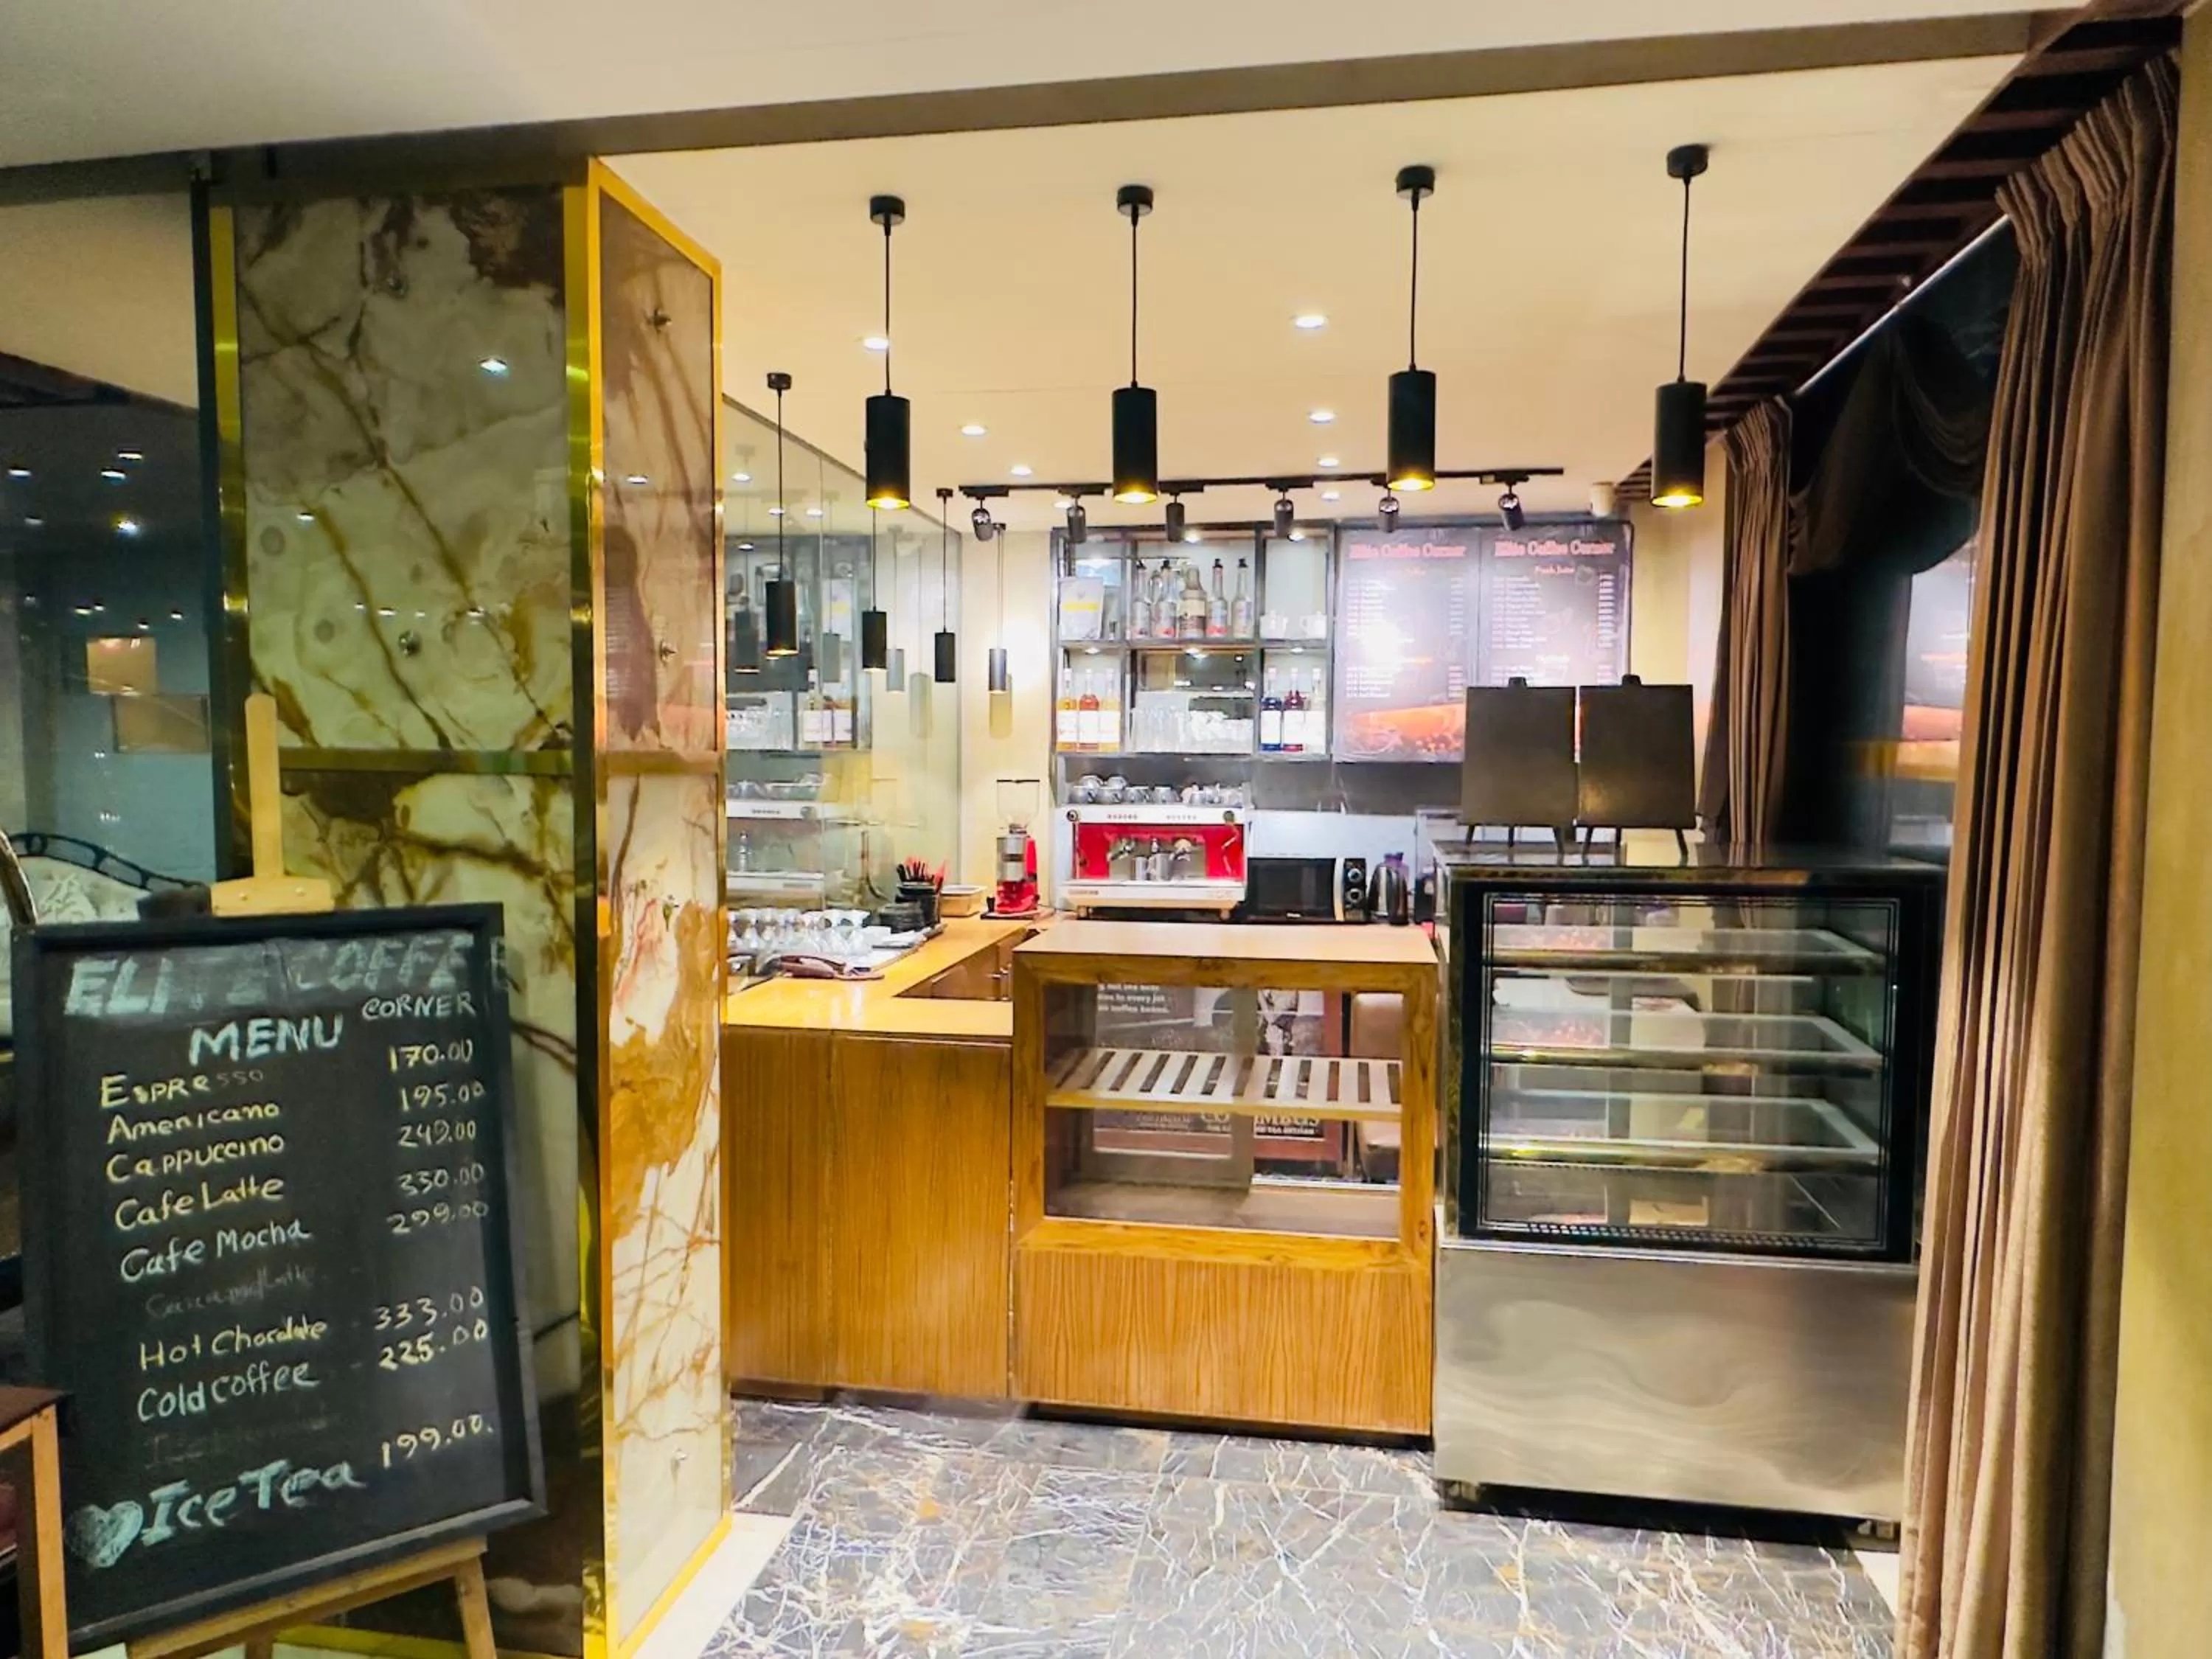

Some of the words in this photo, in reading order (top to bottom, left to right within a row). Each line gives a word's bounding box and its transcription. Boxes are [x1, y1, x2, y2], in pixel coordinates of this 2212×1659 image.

[362, 991, 476, 1020] CORNER
[189, 1014, 344, 1066] MENU
[389, 1038, 473, 1072] 170.00
[400, 1080, 485, 1112] 195.00
[115, 1189, 195, 1231] Cafe
[201, 1174, 285, 1210] Latte
[120, 1237, 206, 1282] Cafe
[216, 1218, 313, 1258] Mocha
[139, 1333, 202, 1370] Hot
[373, 1285, 484, 1330] 333.00
[137, 1381, 206, 1422] Cold
[378, 1318, 488, 1371] 225.00
[142, 1478, 238, 1547] Ice
[237, 1458, 367, 1510] Tea
